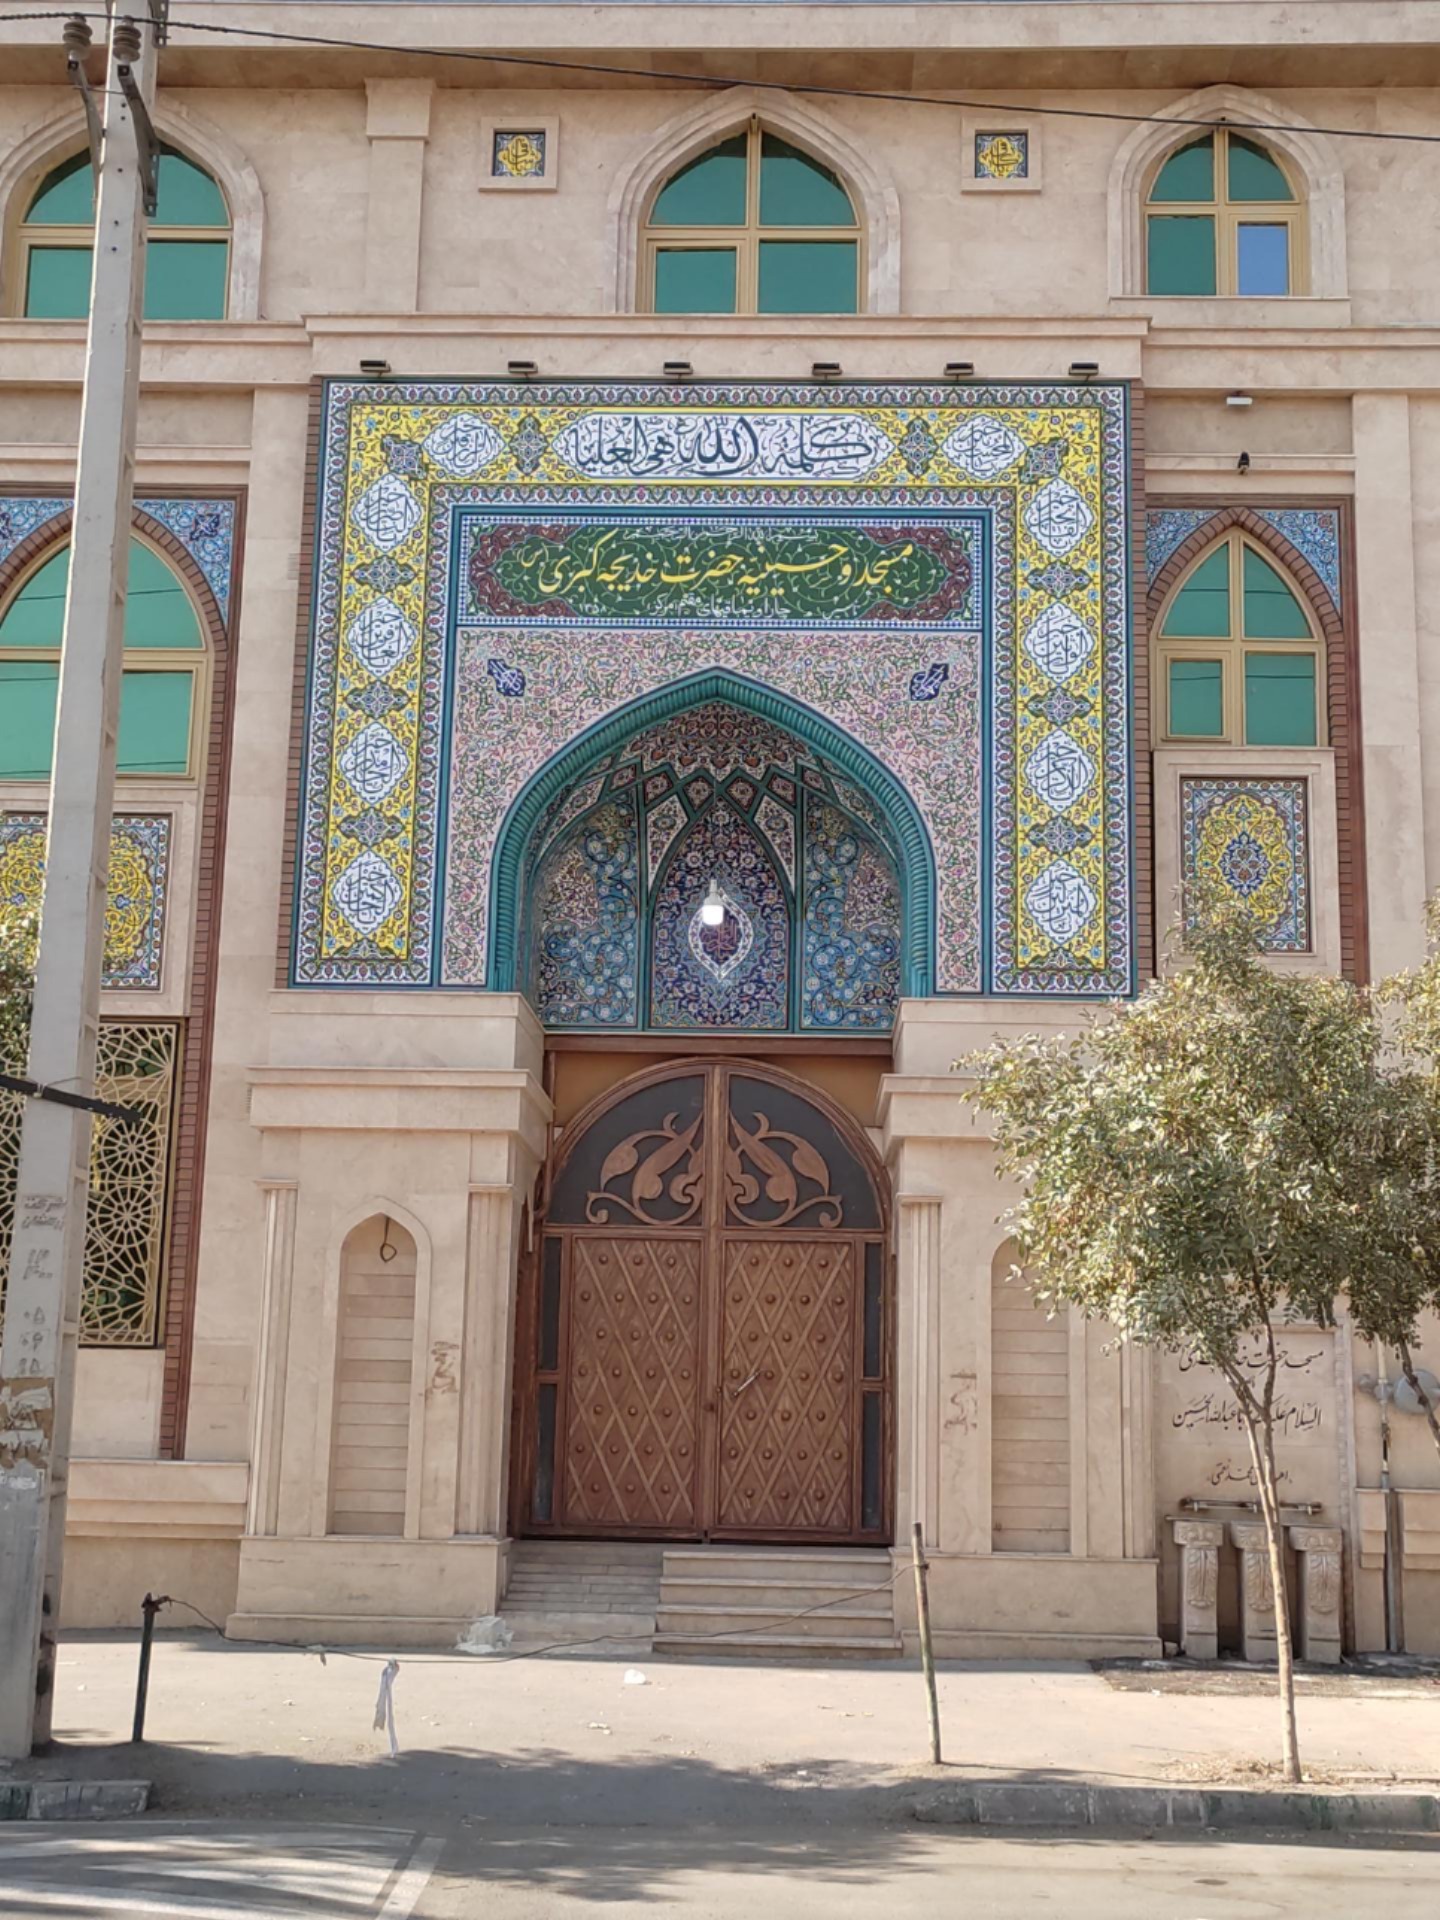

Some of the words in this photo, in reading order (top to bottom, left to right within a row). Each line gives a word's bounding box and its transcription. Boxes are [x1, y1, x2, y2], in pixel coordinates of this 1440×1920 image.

[678, 415, 760, 476] الله
[538, 528, 620, 594] کبری
[597, 551, 657, 592] خدیجه
[660, 549, 744, 591] حضرت
[737, 544, 849, 596] حسینیه
[838, 564, 852, 585] و
[853, 544, 913, 593] مسجد
[1280, 1350, 1324, 1373] مسجد
[1284, 1402, 1322, 1436] السلام
